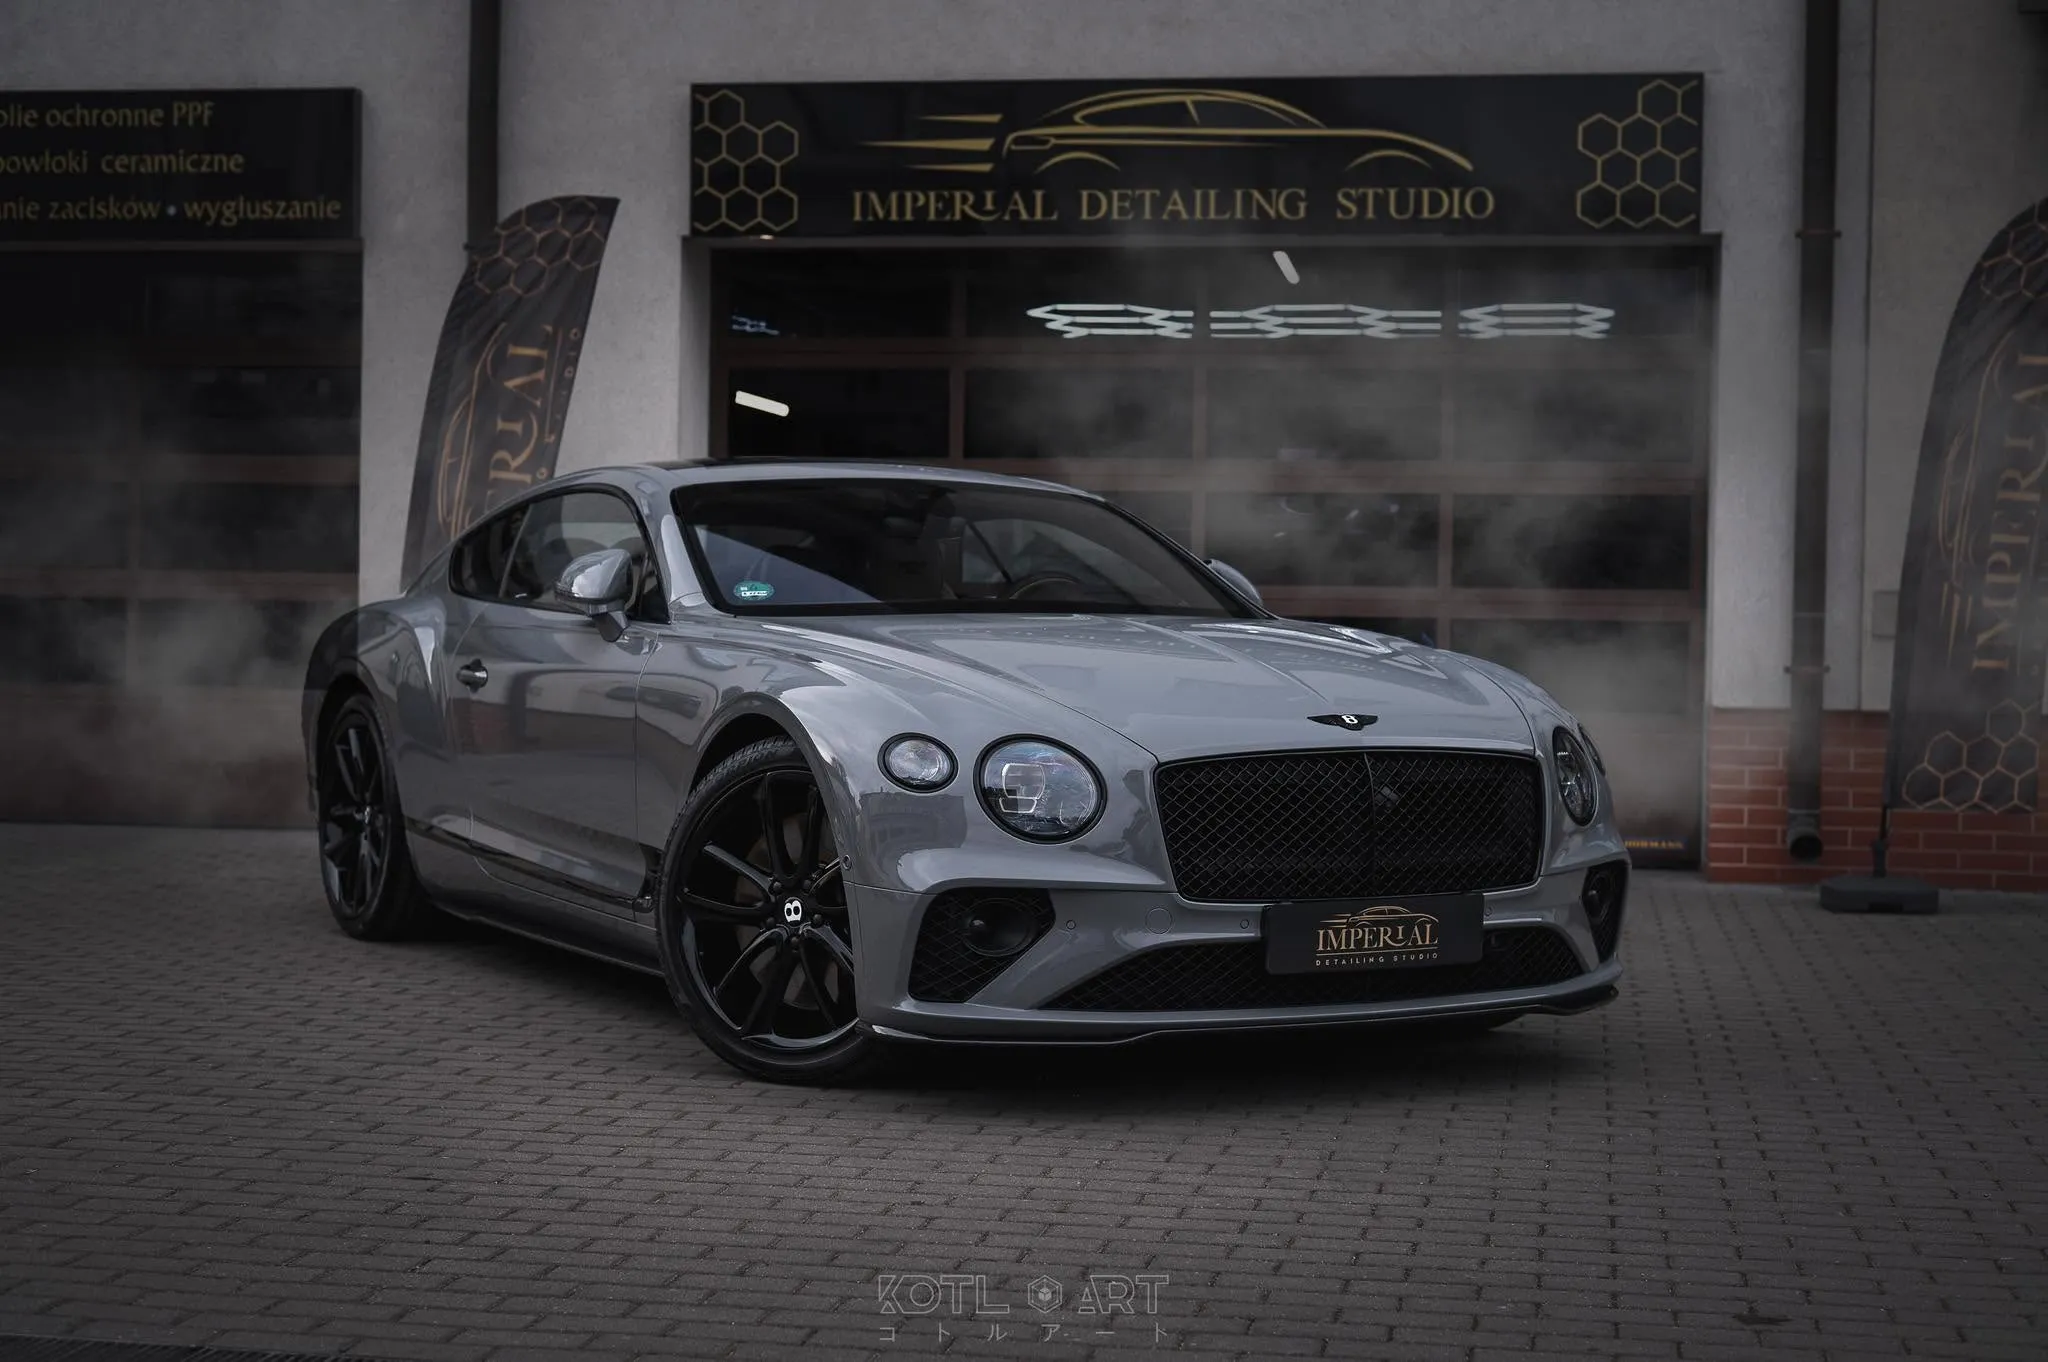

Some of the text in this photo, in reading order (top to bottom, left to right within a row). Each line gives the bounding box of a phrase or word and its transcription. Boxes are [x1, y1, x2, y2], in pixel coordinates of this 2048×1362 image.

[45, 102, 165, 128] ochronne
[173, 100, 215, 127] PPF
[101, 148, 245, 175] ceramiczne
[0, 195, 41, 221] nie
[48, 193, 160, 221] zacisków
[852, 186, 1496, 222] IMPERIAL DETAILING STUDIO
[1316, 923, 1439, 951] IMPERIAL
[1315, 952, 1439, 967] DETAILING STUDIO
